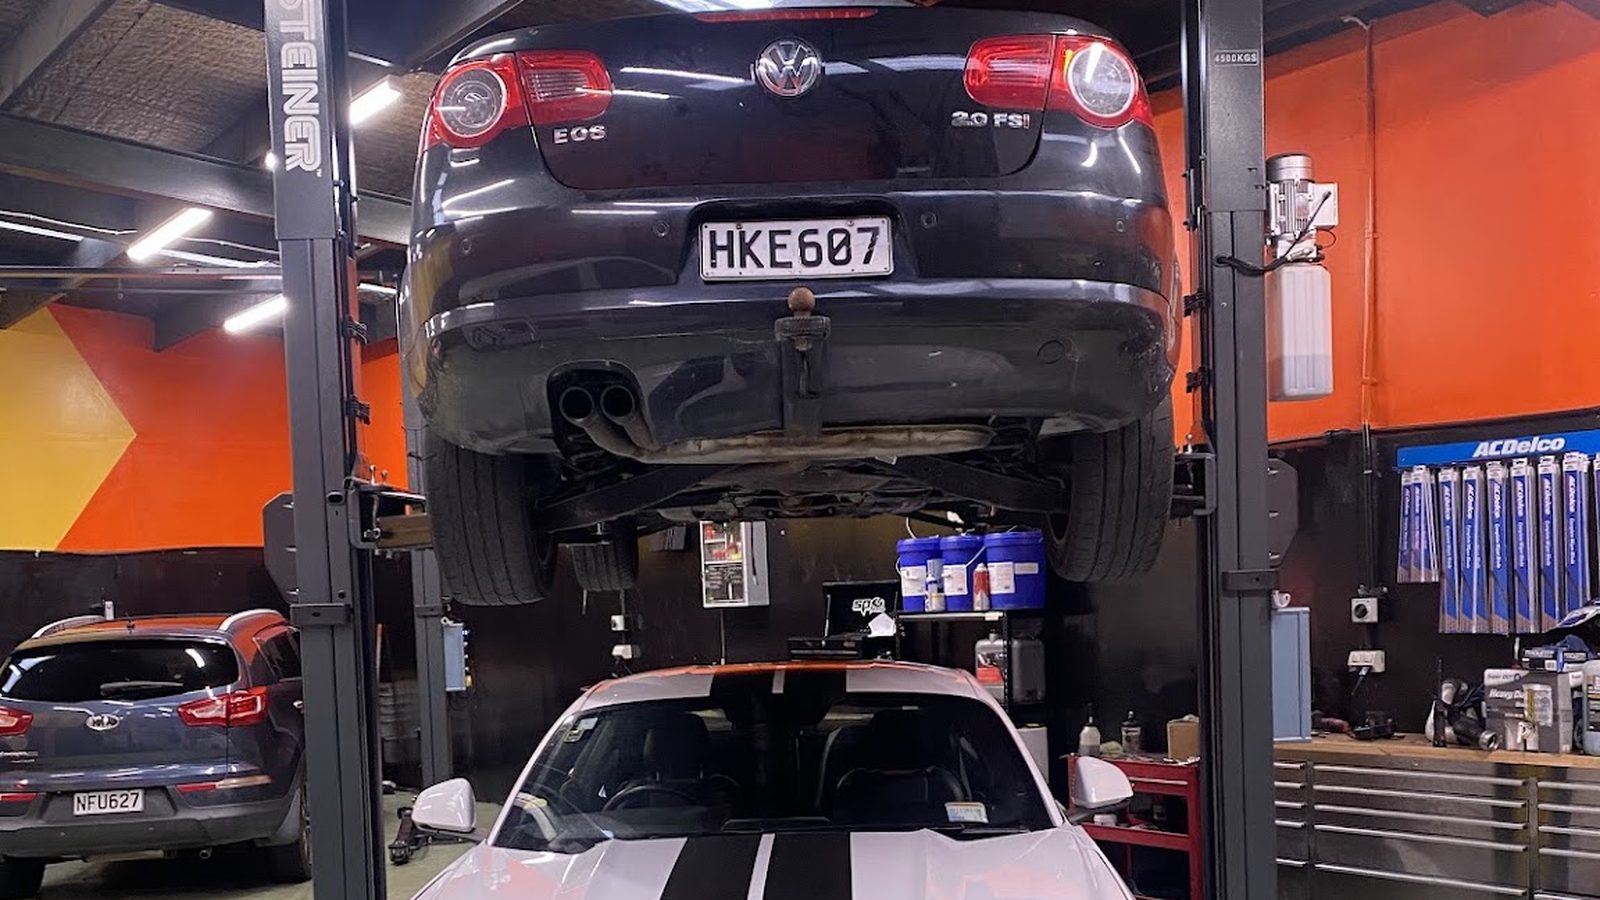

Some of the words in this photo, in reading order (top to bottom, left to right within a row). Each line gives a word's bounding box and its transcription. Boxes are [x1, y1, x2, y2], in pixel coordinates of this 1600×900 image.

[1215, 53, 1257, 63] 4500KGS
[951, 111, 988, 127] 2.0
[993, 112, 1030, 128] FSI
[553, 125, 606, 144] EOS
[709, 226, 880, 269] HKE607
[1472, 436, 1566, 458] ACDelco
[1489, 688, 1513, 700] Heavy
[76, 793, 139, 811] NFU627
